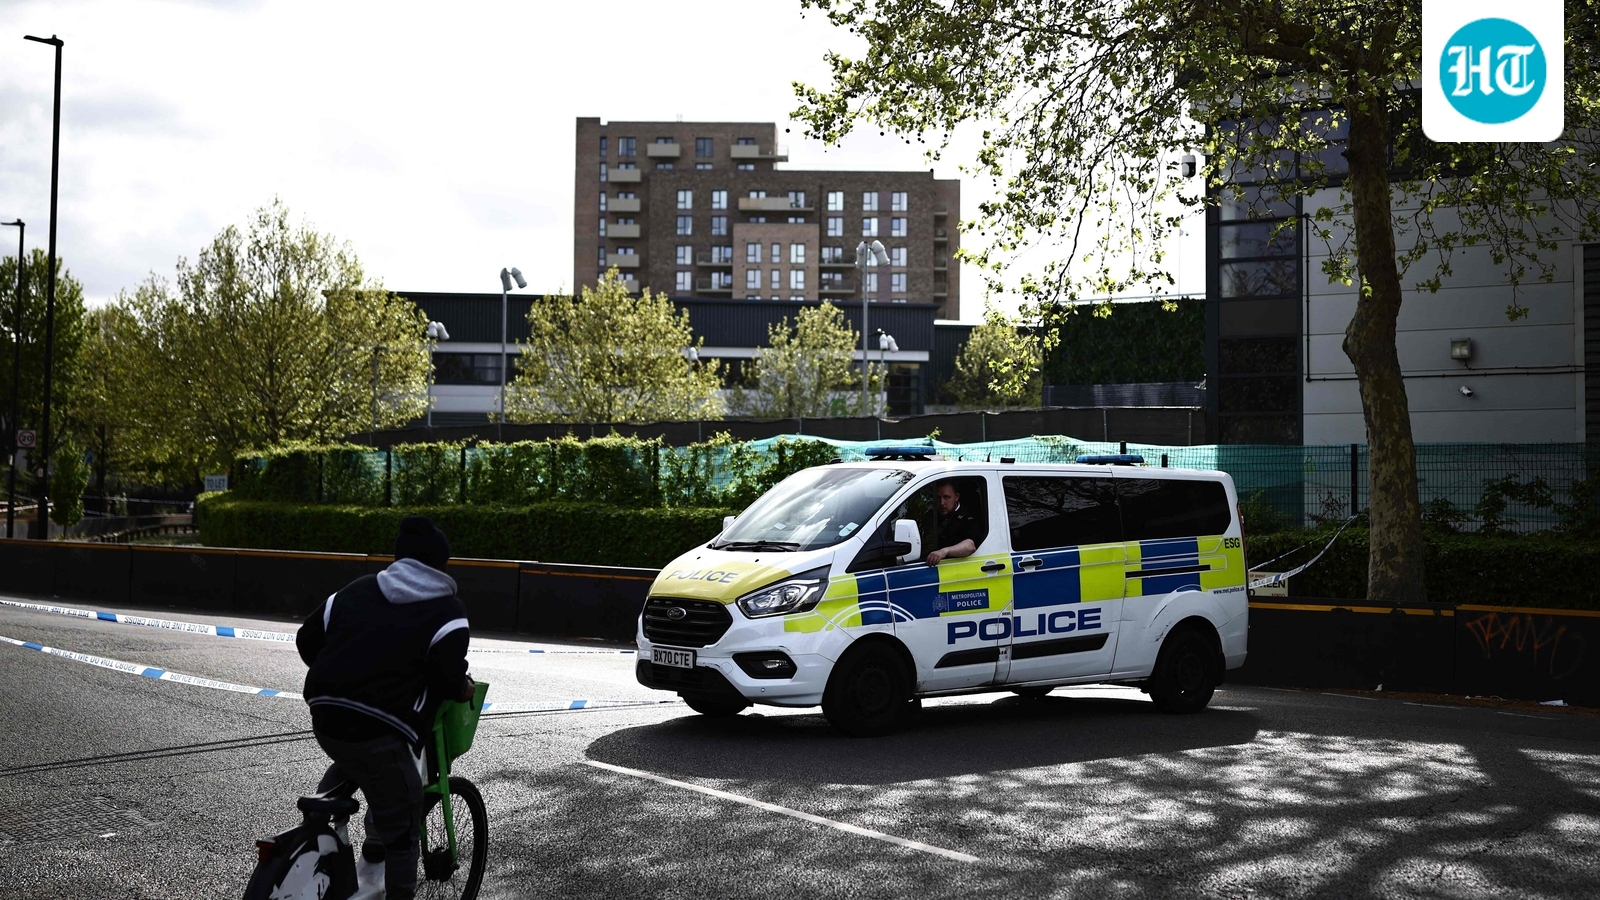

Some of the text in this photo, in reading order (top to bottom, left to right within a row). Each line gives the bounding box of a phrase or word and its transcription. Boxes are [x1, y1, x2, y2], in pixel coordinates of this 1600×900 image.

[21, 434, 33, 442] 20
[206, 478, 226, 489] TO LET
[1224, 537, 1240, 549] ESG
[665, 569, 739, 584] POLICE
[951, 592, 986, 600] METROPOLITAN
[956, 599, 982, 608] POLICE
[124, 616, 210, 634] POLICE LINE DO NOT CROSS
[947, 607, 1102, 645] POLICE
[242, 630, 263, 639] CROSS
[263, 632, 276, 640] NOT
[276, 633, 286, 641] DO
[653, 650, 690, 667] BX70 CTE
